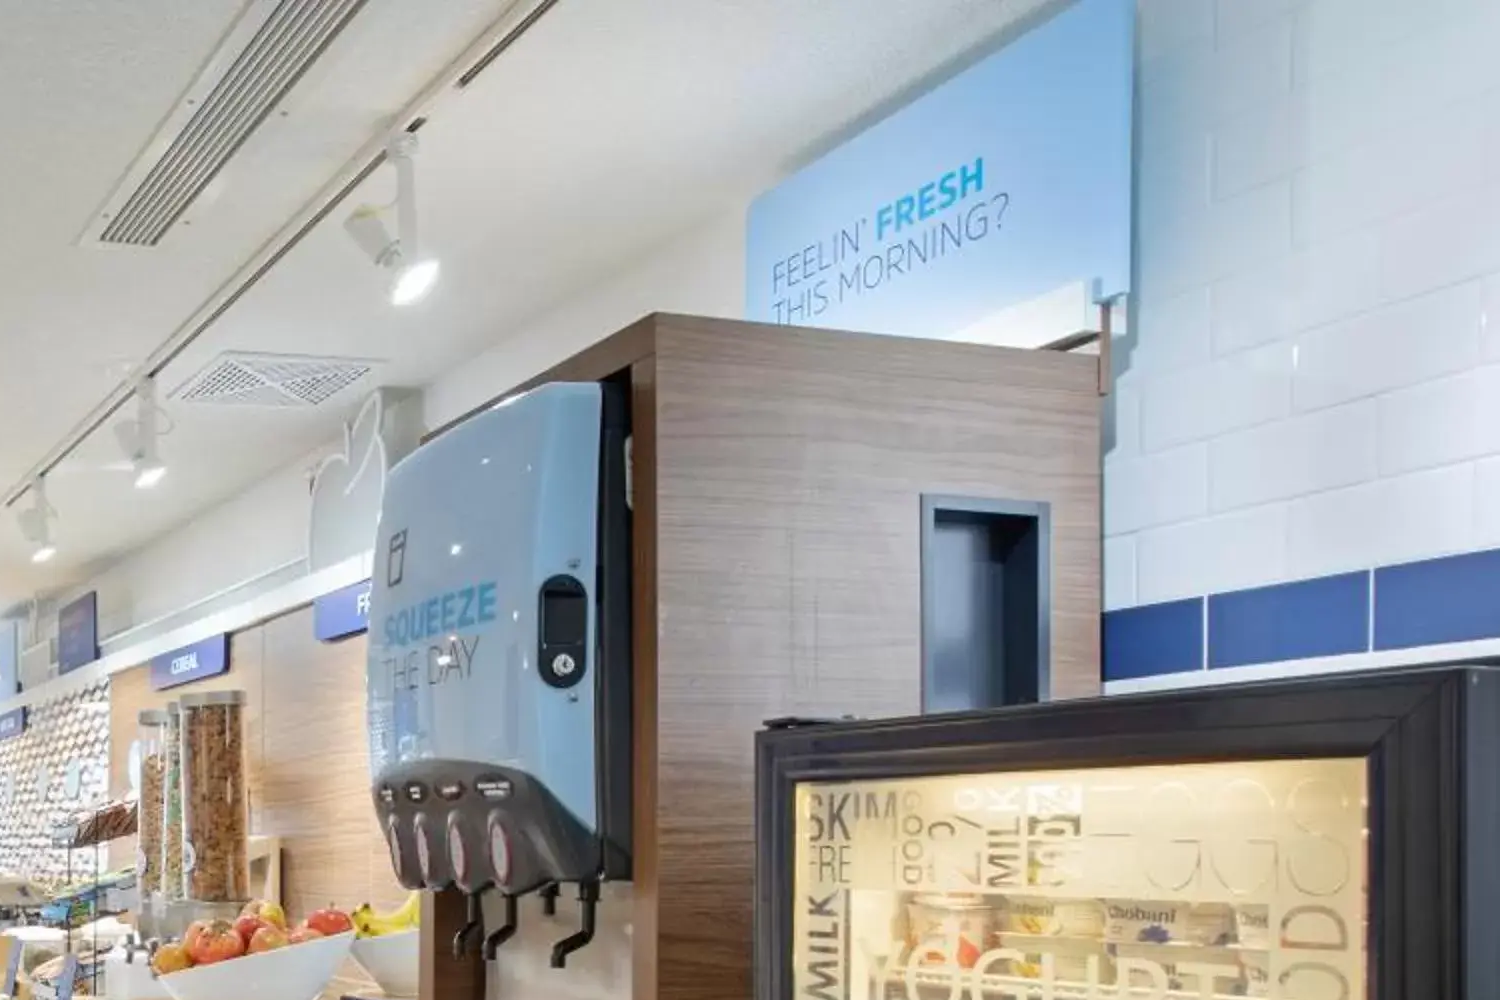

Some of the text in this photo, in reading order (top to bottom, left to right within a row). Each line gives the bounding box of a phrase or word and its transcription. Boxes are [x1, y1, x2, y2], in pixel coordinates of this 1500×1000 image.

[771, 192, 1010, 327] THIS MORNING?
[772, 157, 984, 294] FEELIN' FRESH
[383, 634, 480, 693] THE DAY
[384, 581, 497, 649] SQUEEZE
[985, 785, 1021, 888] MILK
[806, 889, 840, 1000] MILK
[1107, 903, 1177, 923] Chobani
